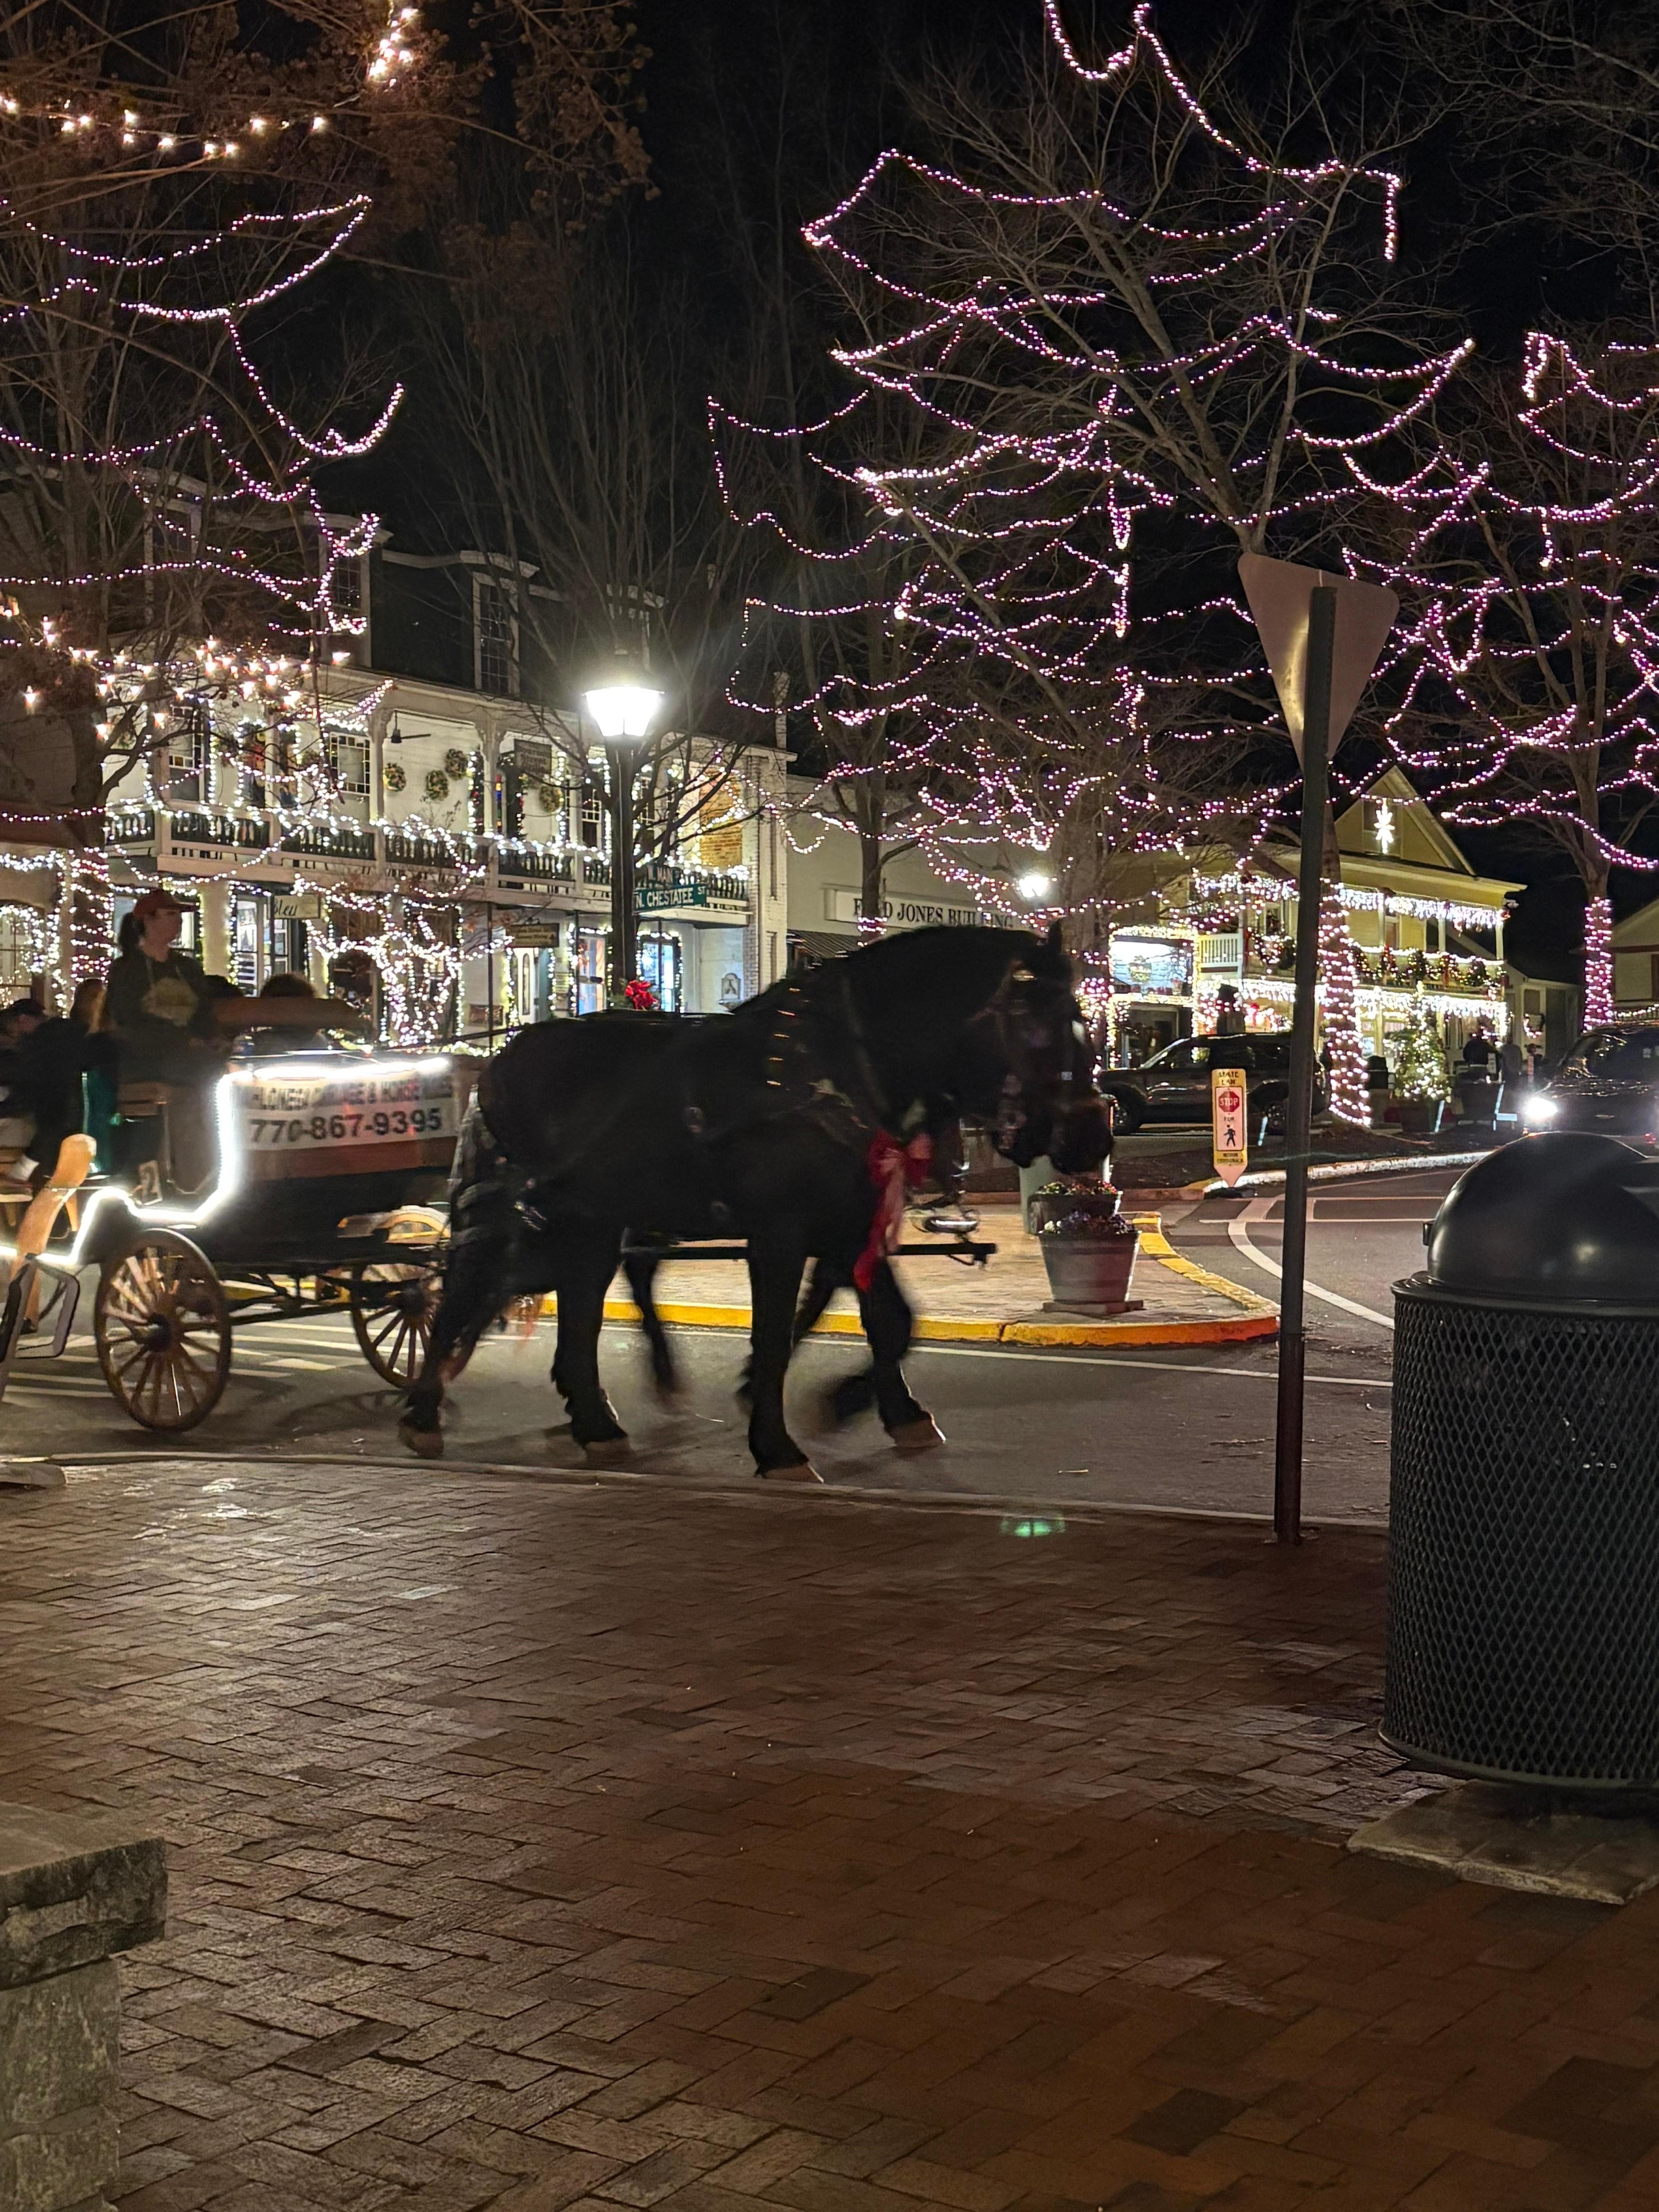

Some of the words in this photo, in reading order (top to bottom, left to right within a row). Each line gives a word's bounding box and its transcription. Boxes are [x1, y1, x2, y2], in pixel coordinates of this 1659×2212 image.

[636, 891, 645, 909] N.
[647, 887, 694, 907] CHESTATEE
[698, 886, 706, 895] ST
[854, 898, 893, 918] FD
[898, 903, 942, 922] JONES
[1220, 1097, 1238, 1106] STOP
[249, 1108, 441, 1142] 770-867-9395
